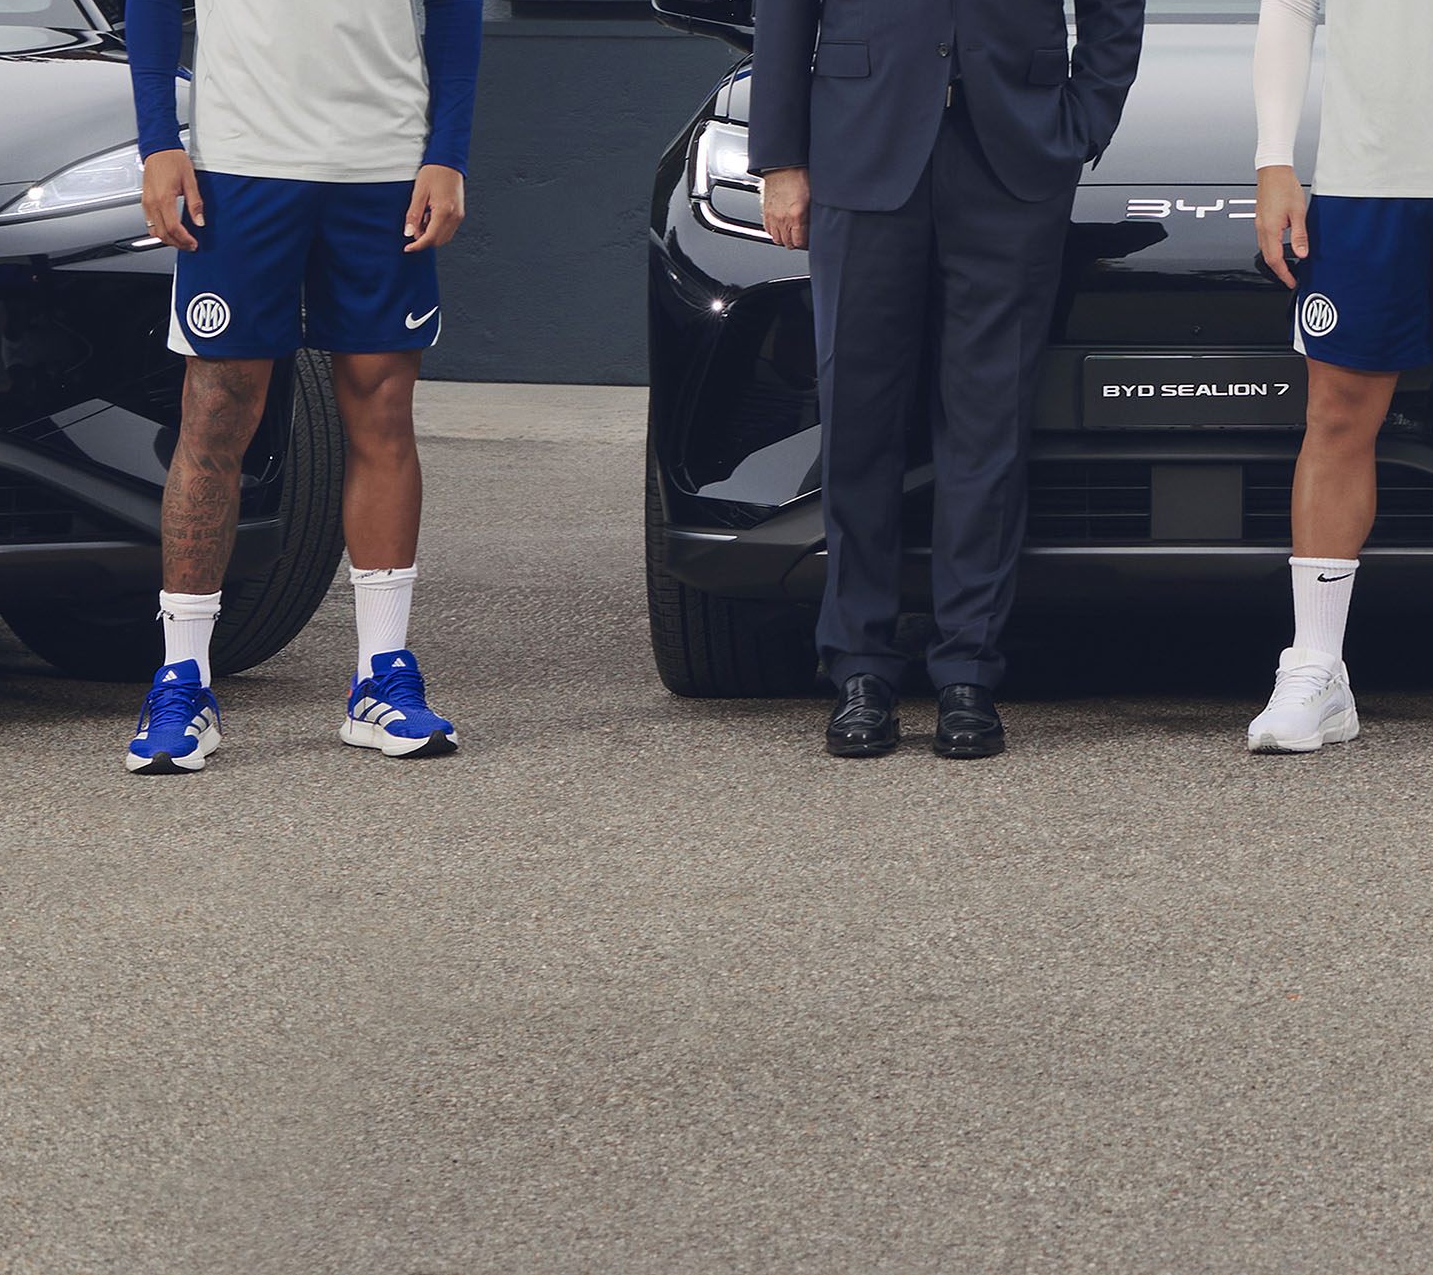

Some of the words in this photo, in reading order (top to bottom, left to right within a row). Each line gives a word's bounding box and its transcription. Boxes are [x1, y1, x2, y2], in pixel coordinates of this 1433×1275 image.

[1103, 384, 1155, 397] BYD
[1160, 384, 1268, 396] SEALION
[1274, 384, 1289, 395] 7
